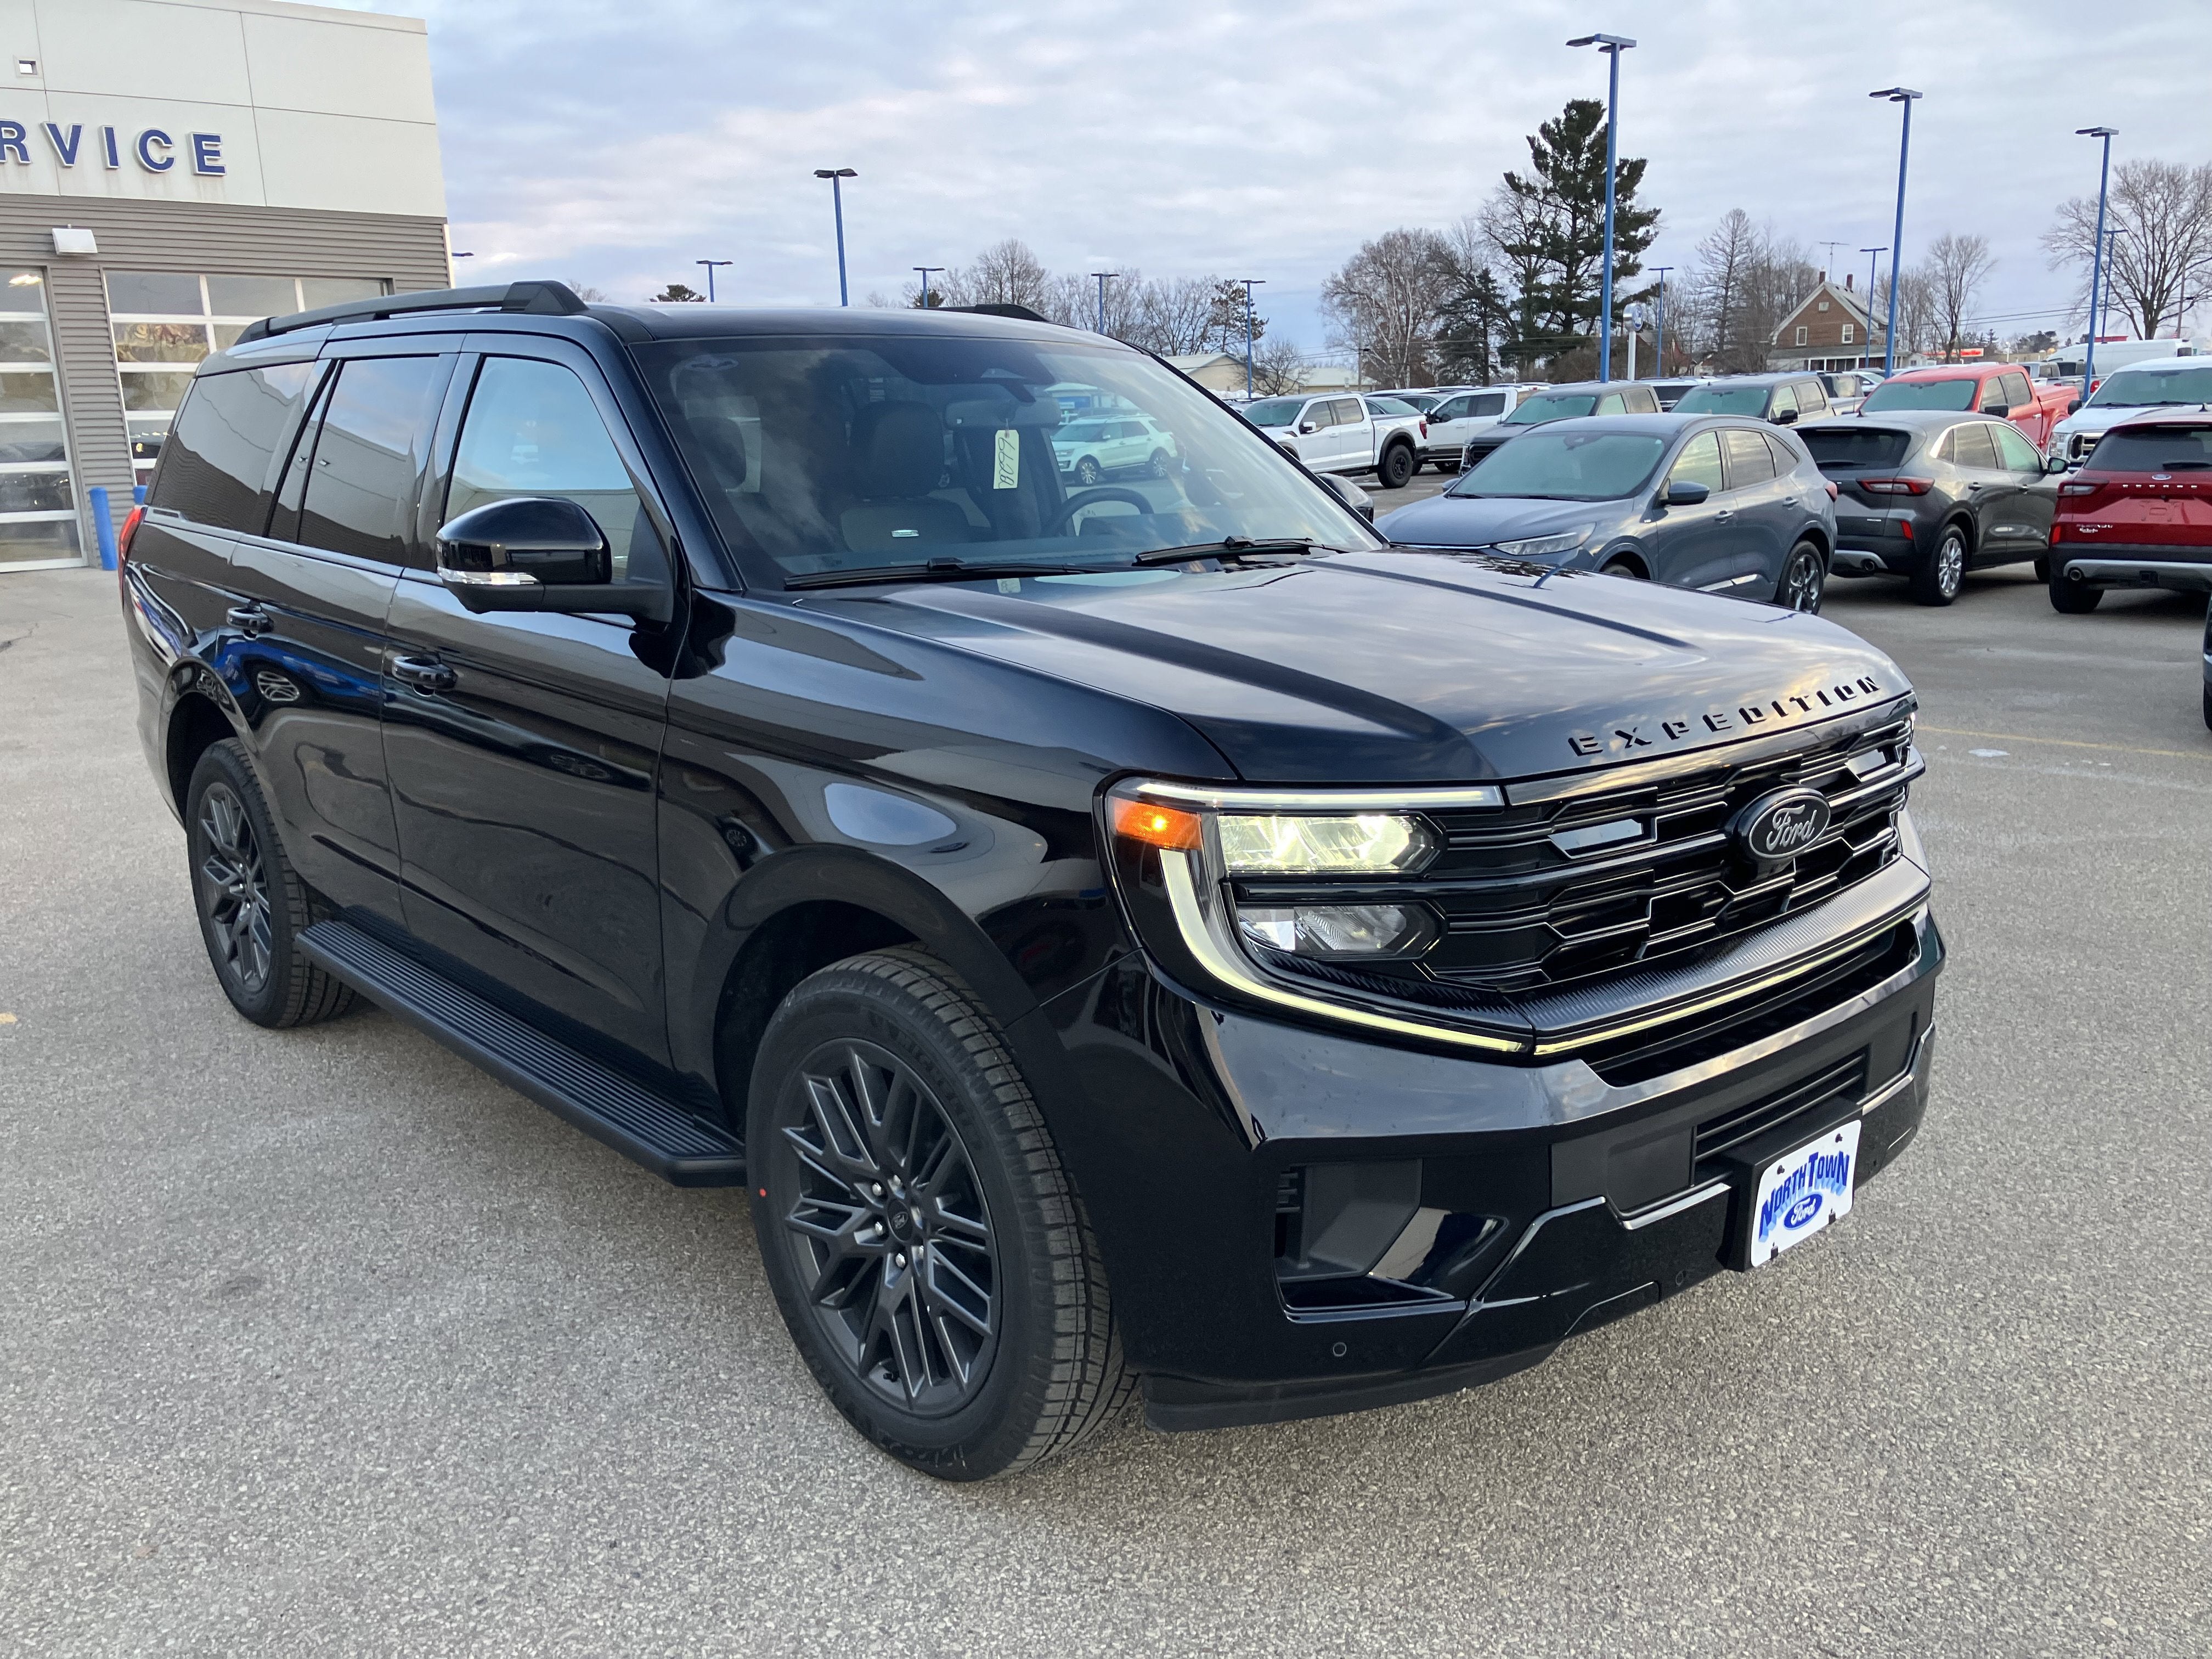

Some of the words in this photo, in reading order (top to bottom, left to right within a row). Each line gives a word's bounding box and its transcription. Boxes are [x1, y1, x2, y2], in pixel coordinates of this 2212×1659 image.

[0, 119, 226, 176] RVICE
[1568, 676, 1880, 757] EXPEDITION
[1766, 804, 1817, 851] Ford
[1791, 1198, 1816, 1225] Ford
